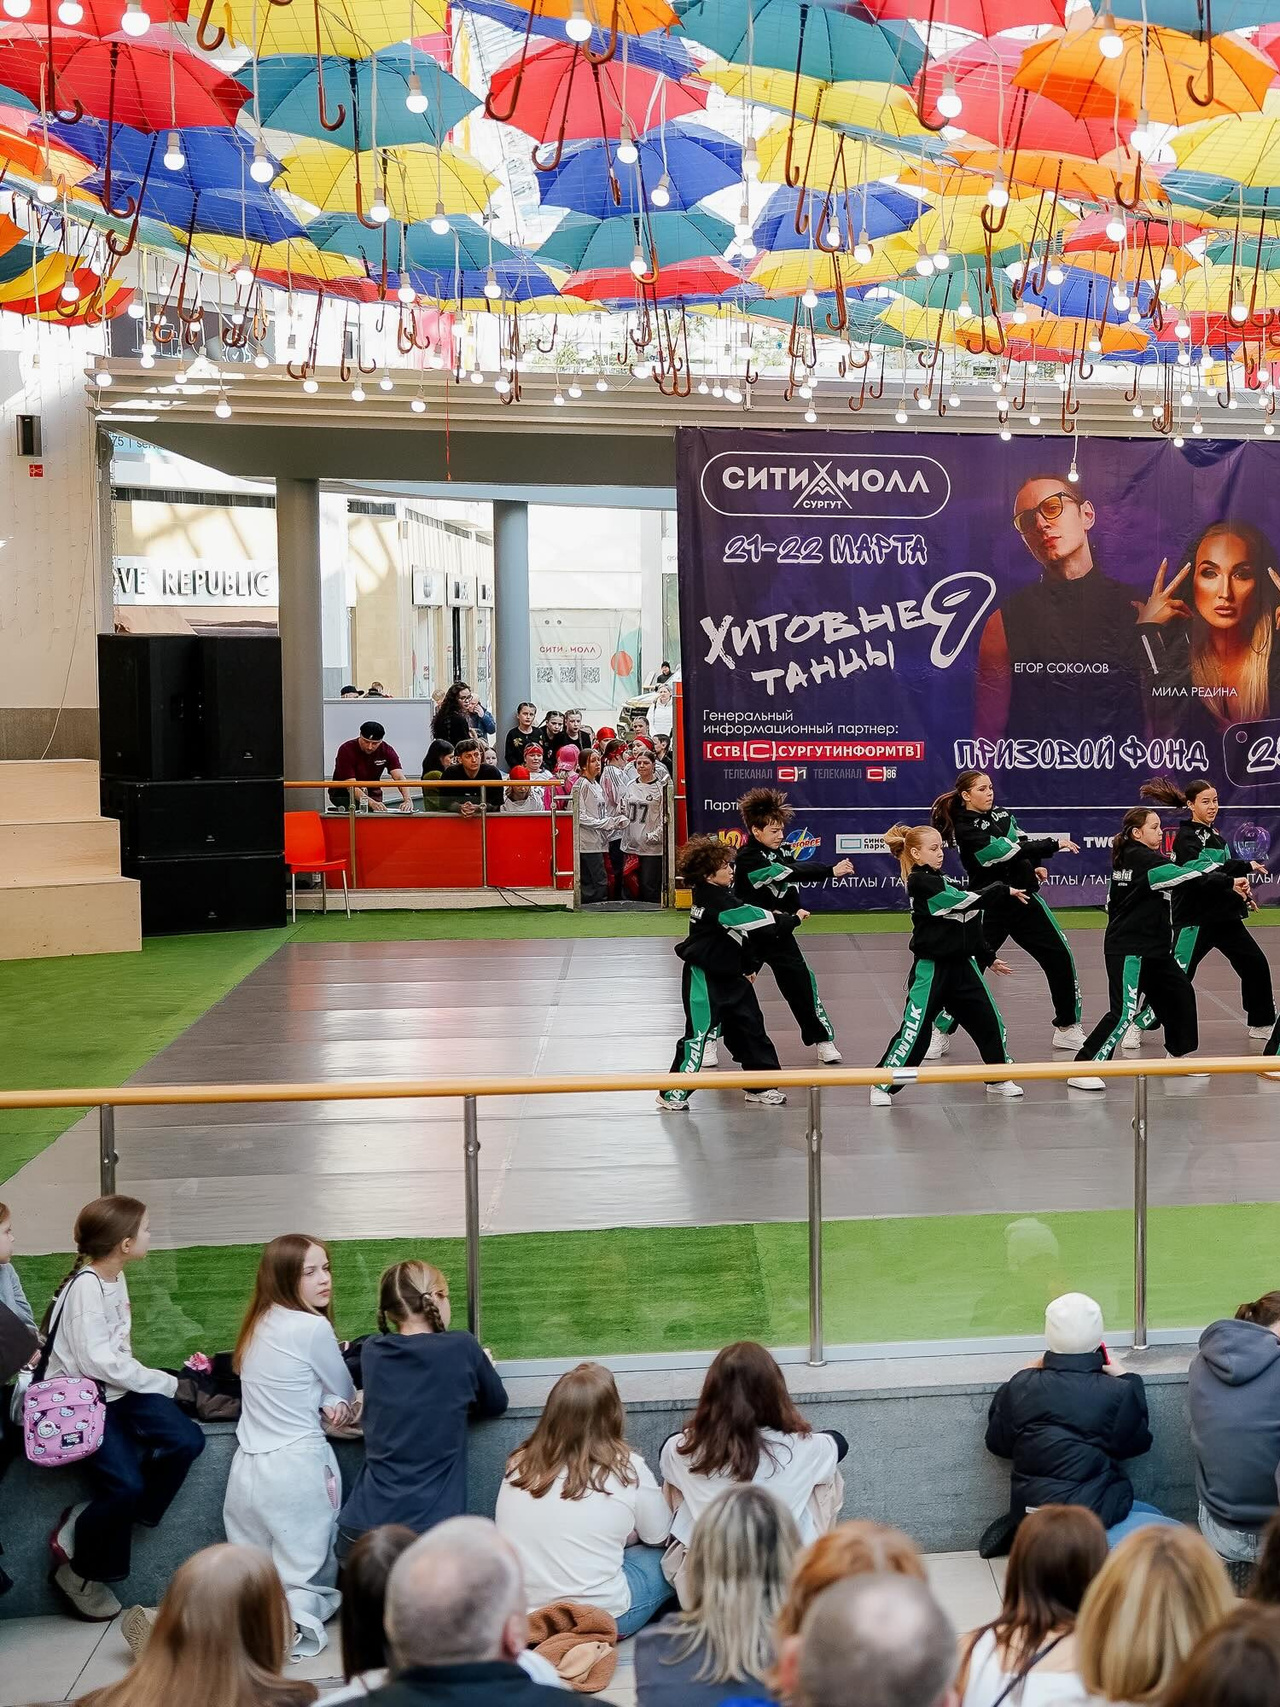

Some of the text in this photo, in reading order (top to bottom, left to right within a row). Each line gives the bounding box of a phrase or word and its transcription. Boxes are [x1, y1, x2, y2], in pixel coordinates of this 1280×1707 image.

[722, 466, 931, 493] СИТИ МОЛЛ
[803, 500, 843, 510] СУРГУТ
[722, 533, 928, 565] 21-22 МАРТА
[115, 567, 270, 597] VE REPUBLIC
[751, 639, 896, 696] ТАНЦЫ
[1013, 662, 1110, 674] ЕГОР СОКОЛОВ
[1151, 686, 1239, 698] МИЛА РЕДИНА
[703, 709, 794, 722] Генеральный
[703, 722, 899, 736] информационный партнер:
[954, 736, 1209, 772] ПРИЗОВОЙ ФОНД
[723, 768, 773, 779] ТЕЛЕКАНАЛ
[813, 768, 862, 779] ТЕЛЕКАНАЛ
[863, 843, 886, 851] парк
[831, 877, 878, 888] БАТТЛЫ
[1038, 874, 1079, 886] АТТЛЫ
